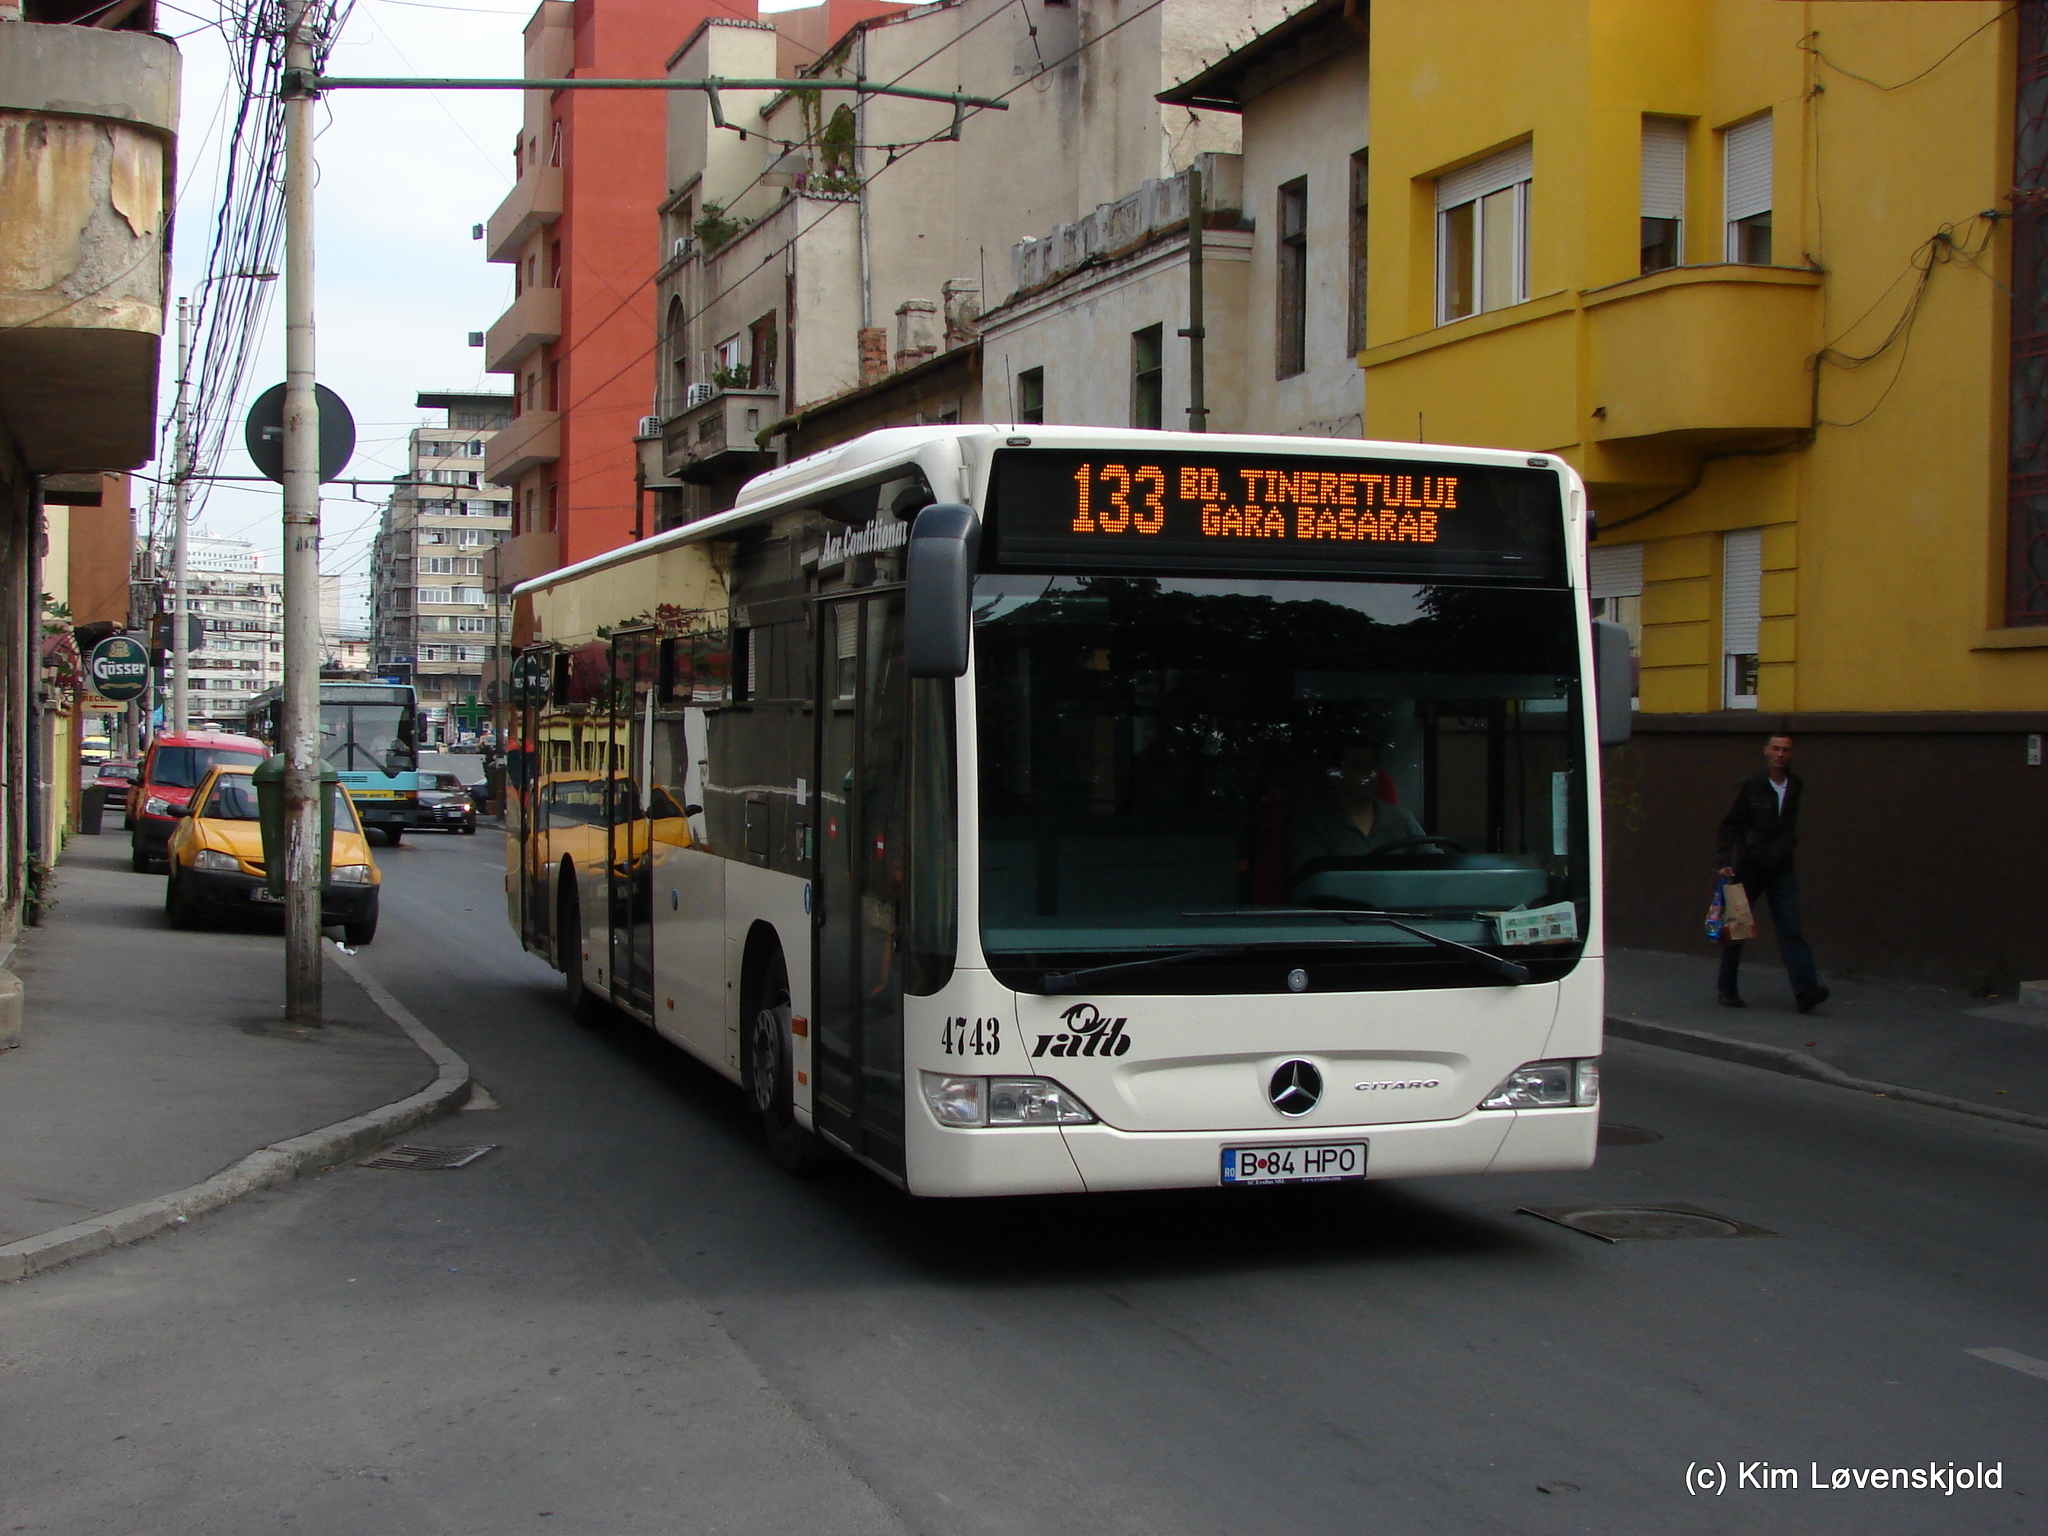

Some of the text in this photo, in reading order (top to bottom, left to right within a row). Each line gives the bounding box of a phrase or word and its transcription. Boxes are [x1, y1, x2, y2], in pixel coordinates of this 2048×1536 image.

[1073, 463, 1165, 534] 133
[1180, 467, 1458, 509] BD. TINERETULUI
[1202, 503, 1438, 543] GARA BASARAB
[822, 531, 842, 561] Aer
[93, 657, 146, 680] Gösser
[941, 1016, 1001, 1056] 4743
[1031, 1016, 1131, 1058] ratb
[1354, 1079, 1440, 1091] CITARO
[1224, 1148, 1355, 1178] RO B 84 HPO
